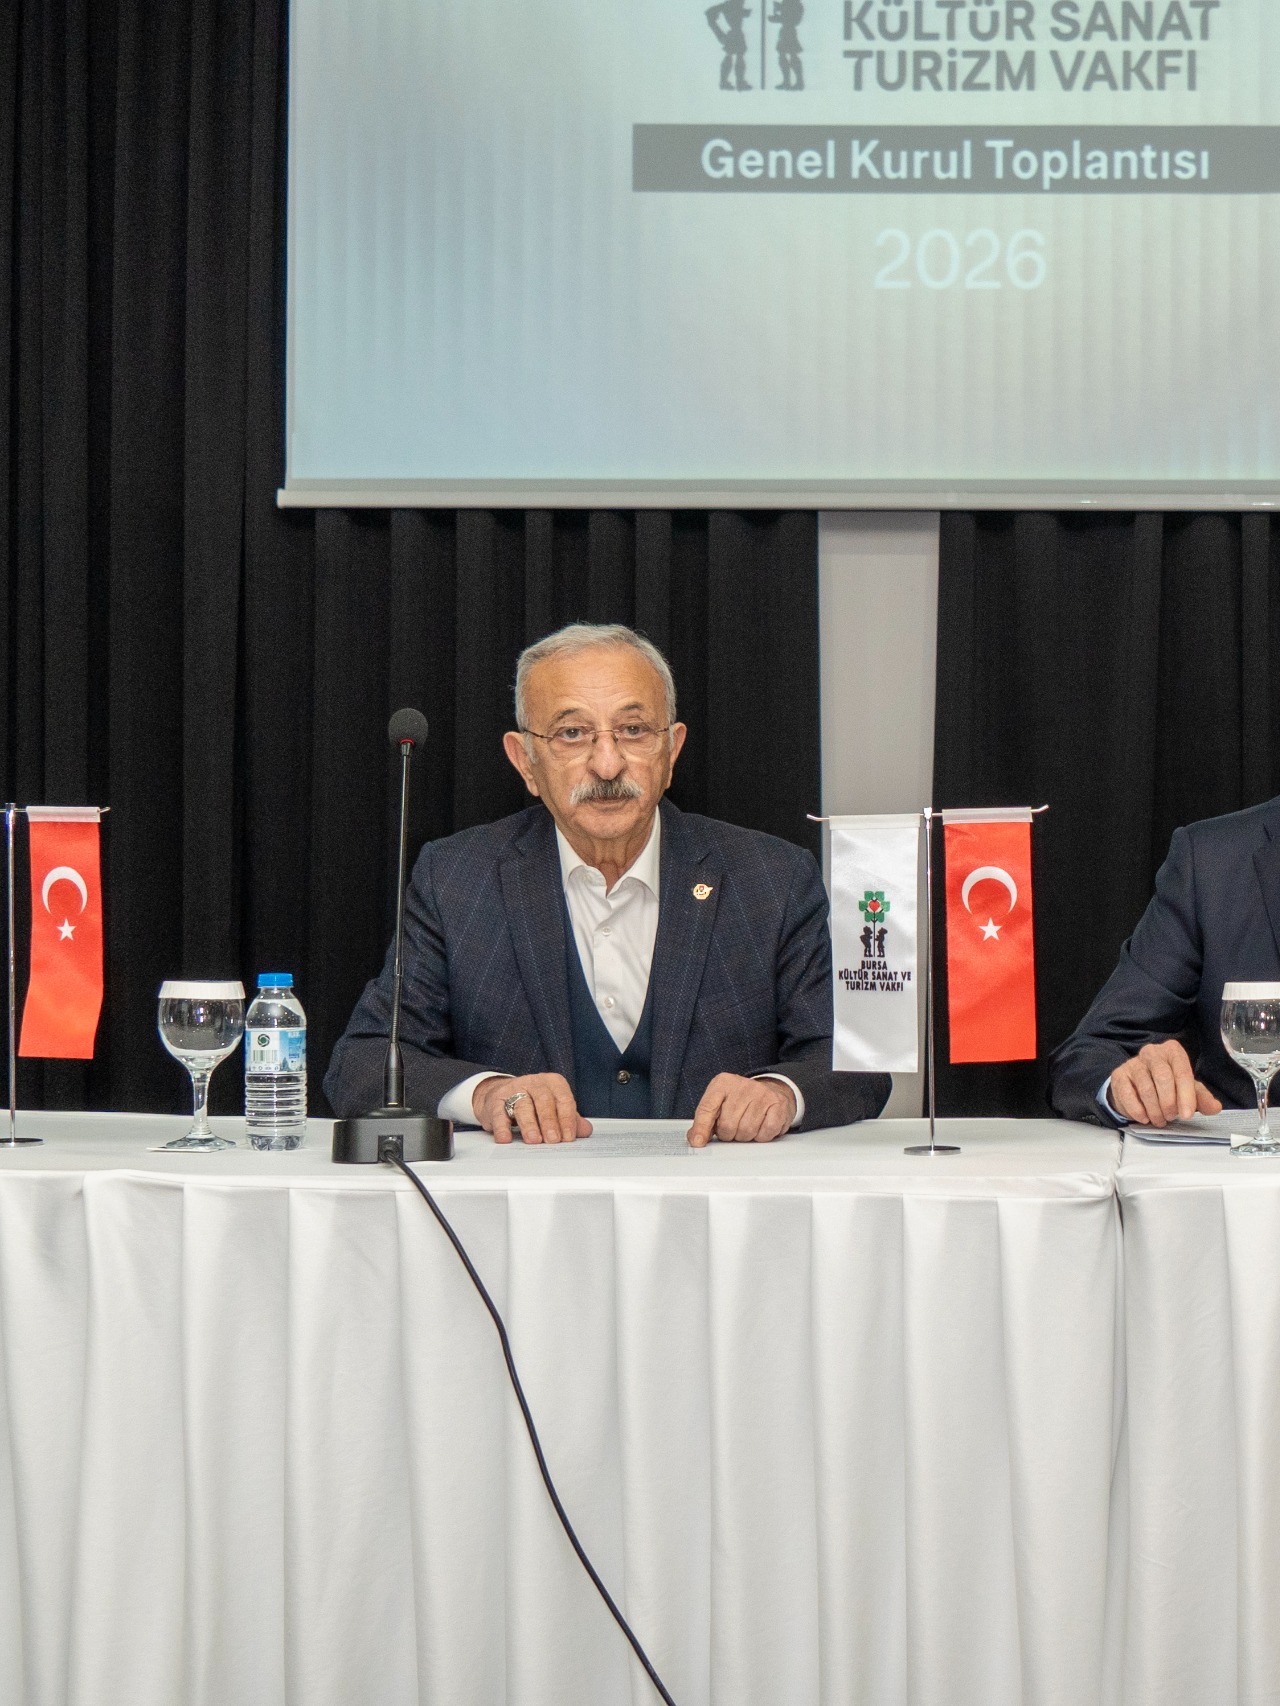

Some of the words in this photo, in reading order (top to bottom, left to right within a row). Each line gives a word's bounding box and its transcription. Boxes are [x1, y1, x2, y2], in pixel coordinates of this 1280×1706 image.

[843, 0, 1036, 42] KÜLTÜR
[1050, 0, 1220, 42] SANAT
[1049, 49, 1198, 91] VAKFI
[701, 139, 836, 179] Genel
[851, 140, 973, 180] Kurul
[985, 140, 1210, 189] Toplantısı
[873, 227, 1047, 291] 2026
[838, 968, 868, 980] KÜLTÜR
[871, 971, 898, 981] SANAT
[901, 971, 911, 981] VE
[845, 980, 877, 991] TURİZM
[880, 981, 904, 991] VAKFI
[861, 961, 887, 970] BURSA
